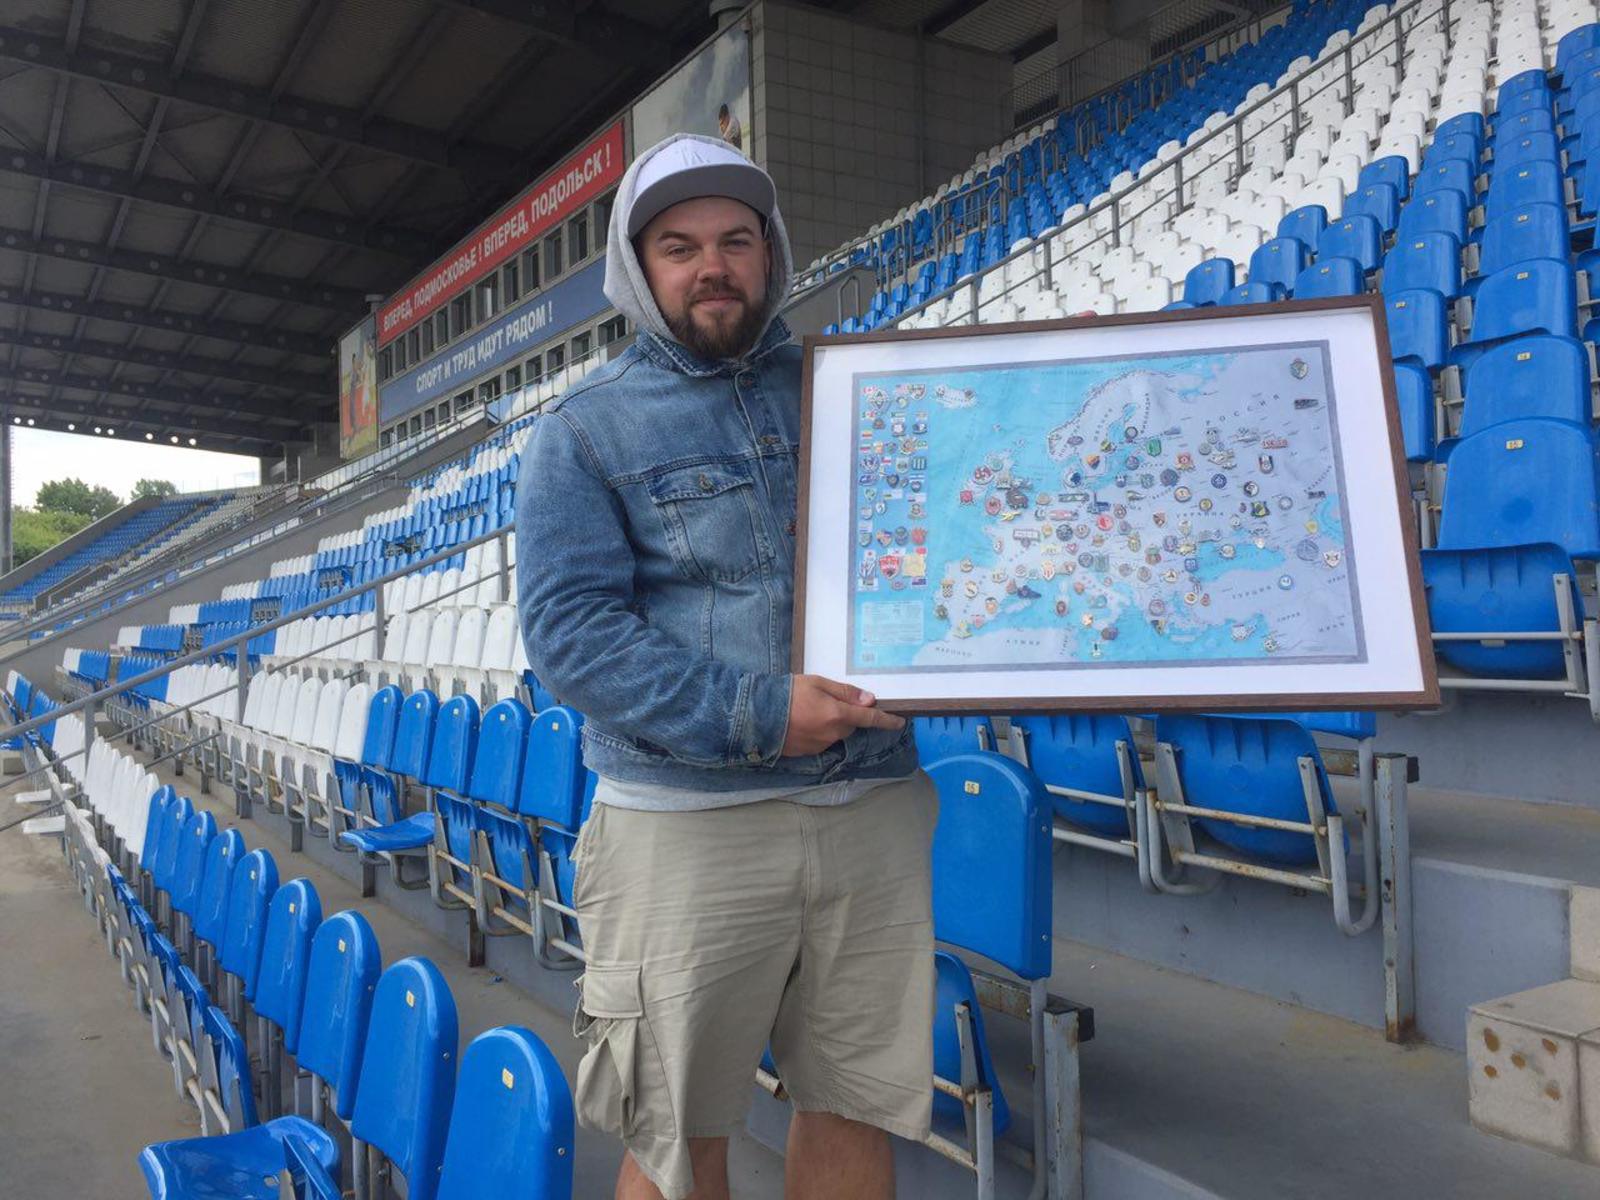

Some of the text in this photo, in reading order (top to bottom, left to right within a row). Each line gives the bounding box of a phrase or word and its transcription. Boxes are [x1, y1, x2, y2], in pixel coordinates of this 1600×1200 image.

[414, 246, 477, 310] ПОДМОСКОВЬЕ
[531, 148, 602, 223] ПОДОЛЬСК
[416, 364, 442, 393] СПОРТ
[443, 359, 451, 379] И
[452, 346, 476, 374] ТРУД
[477, 328, 503, 362] ИДУТ
[505, 304, 546, 346] РЯДОМ
